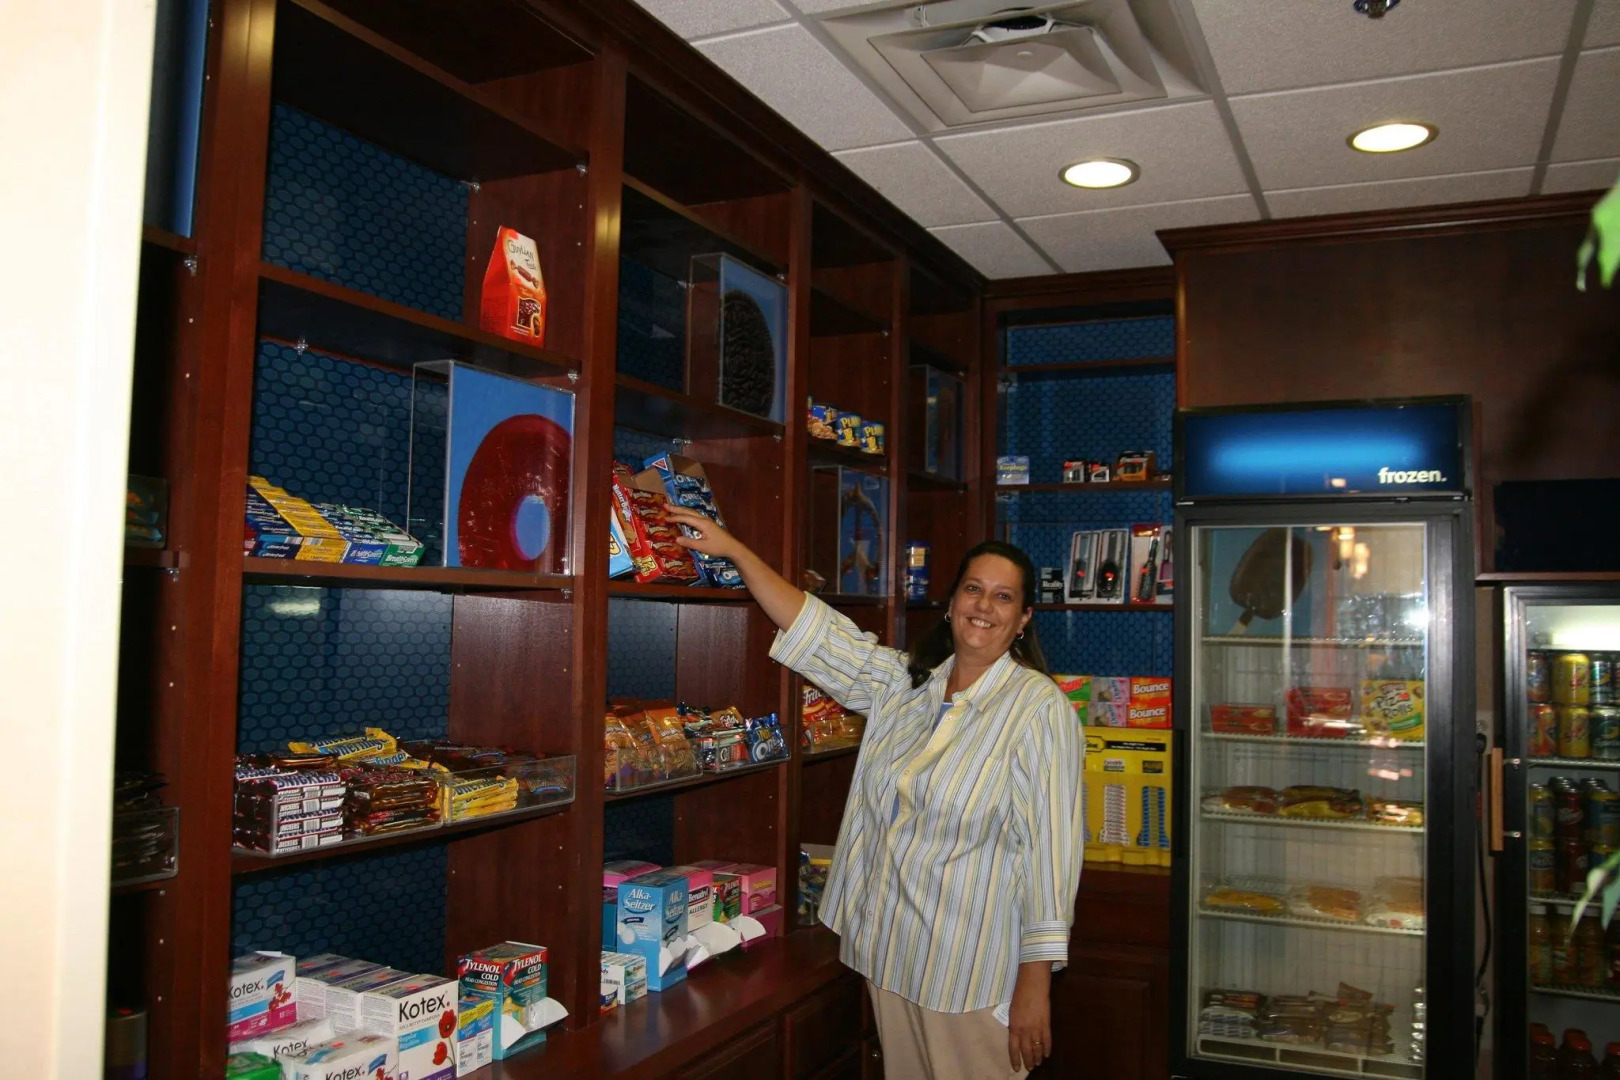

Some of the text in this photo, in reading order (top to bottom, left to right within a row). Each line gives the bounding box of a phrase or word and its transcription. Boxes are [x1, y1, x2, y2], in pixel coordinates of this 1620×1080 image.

[1378, 467, 1448, 484] frozen.
[1133, 682, 1169, 694] Bounce
[1130, 706, 1166, 719] Bounce
[623, 899, 655, 911] Seltzer
[689, 903, 709, 915] ALLERGY
[465, 958, 500, 974] TYLENOL
[513, 953, 543, 972] TYLENOL
[527, 963, 542, 974] COLD
[481, 972, 499, 981] COLD
